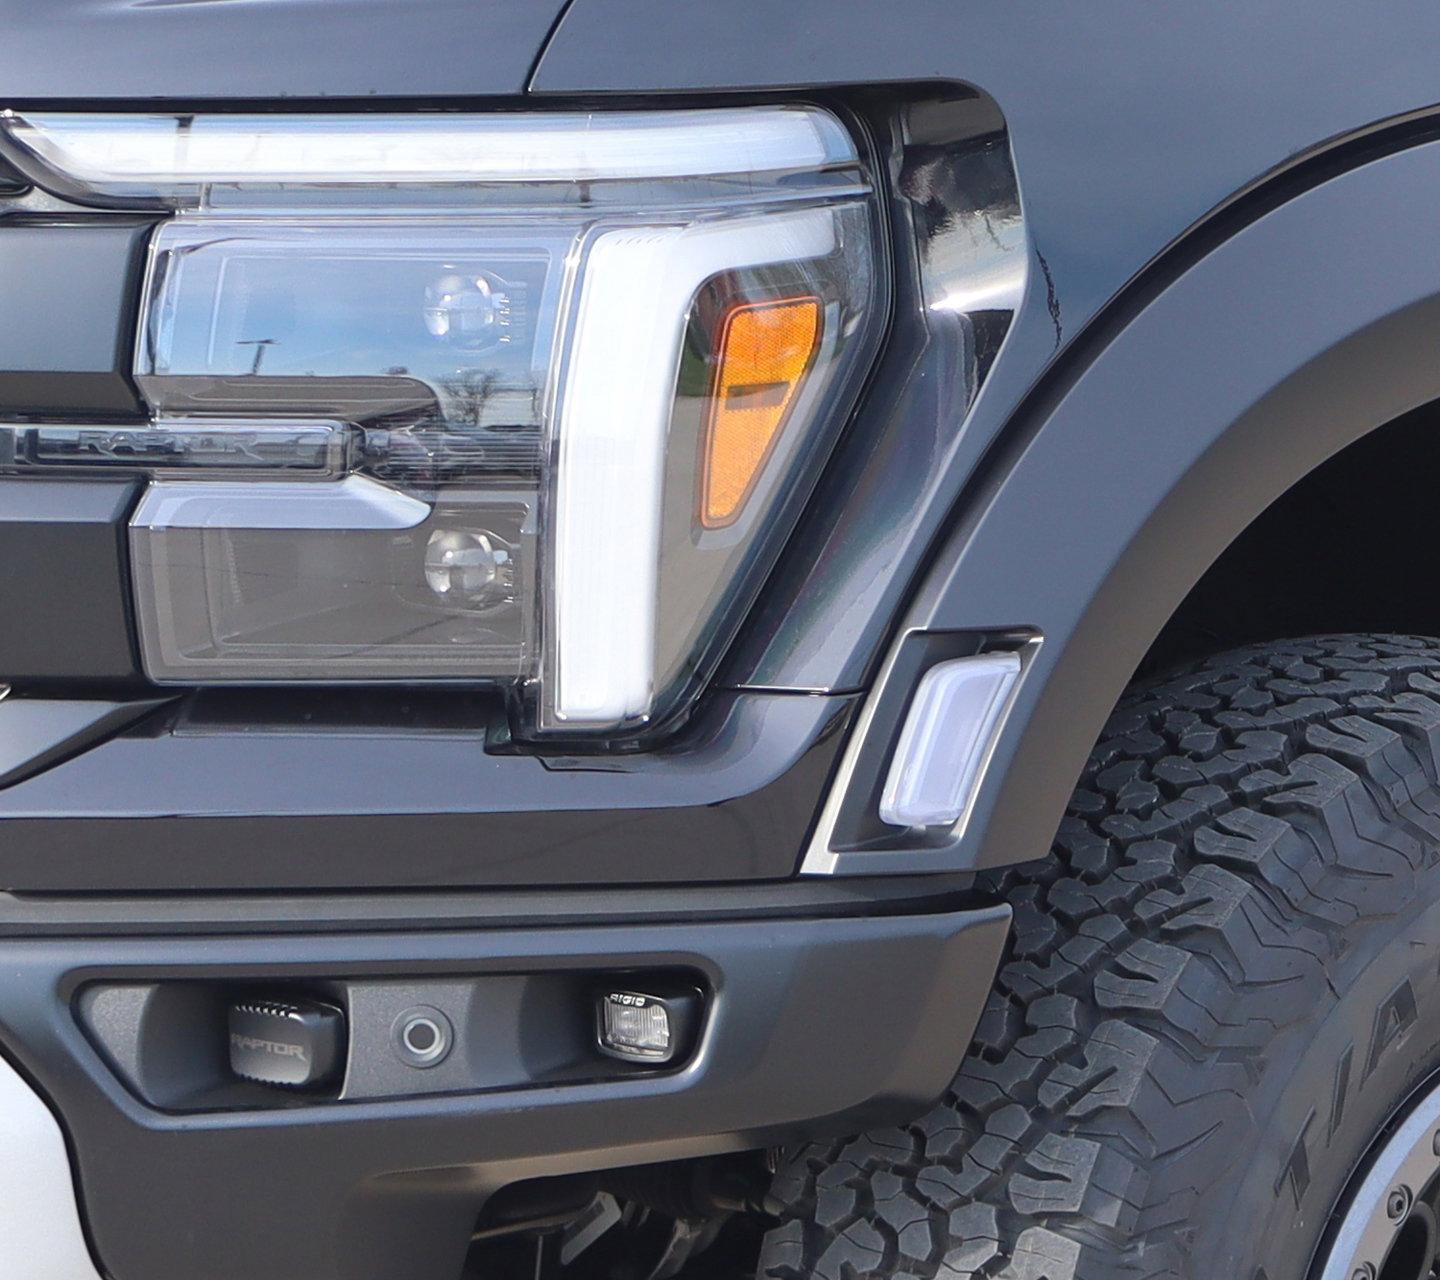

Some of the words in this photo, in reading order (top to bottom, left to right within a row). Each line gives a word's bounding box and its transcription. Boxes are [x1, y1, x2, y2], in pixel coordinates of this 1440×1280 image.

[78, 430, 265, 461] RAPTOR
[609, 992, 646, 1007] RIGID
[231, 1033, 306, 1063] RAPTOR
